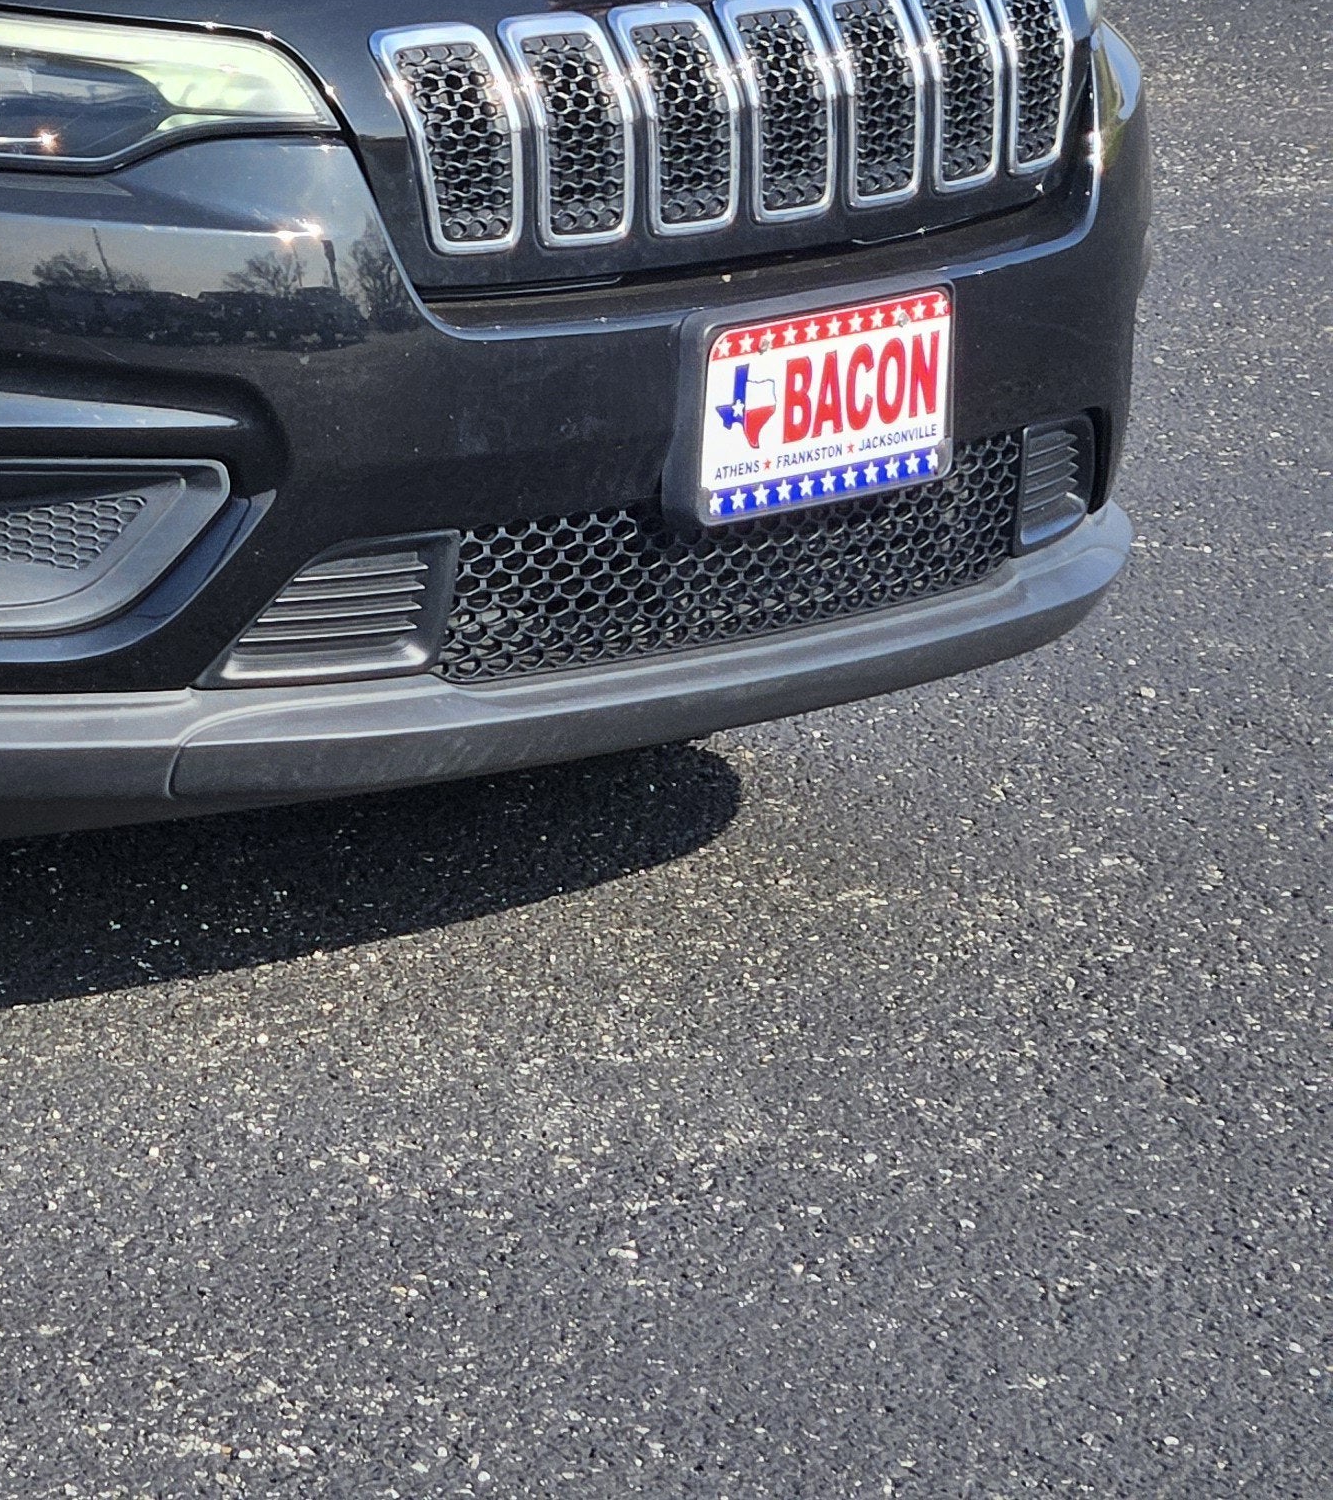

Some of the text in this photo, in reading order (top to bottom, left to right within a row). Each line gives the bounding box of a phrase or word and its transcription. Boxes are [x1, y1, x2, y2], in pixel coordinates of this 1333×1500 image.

[782, 329, 941, 445] BACON
[714, 423, 938, 481] ATHENS FRANKSTON JACKSONVILLE
